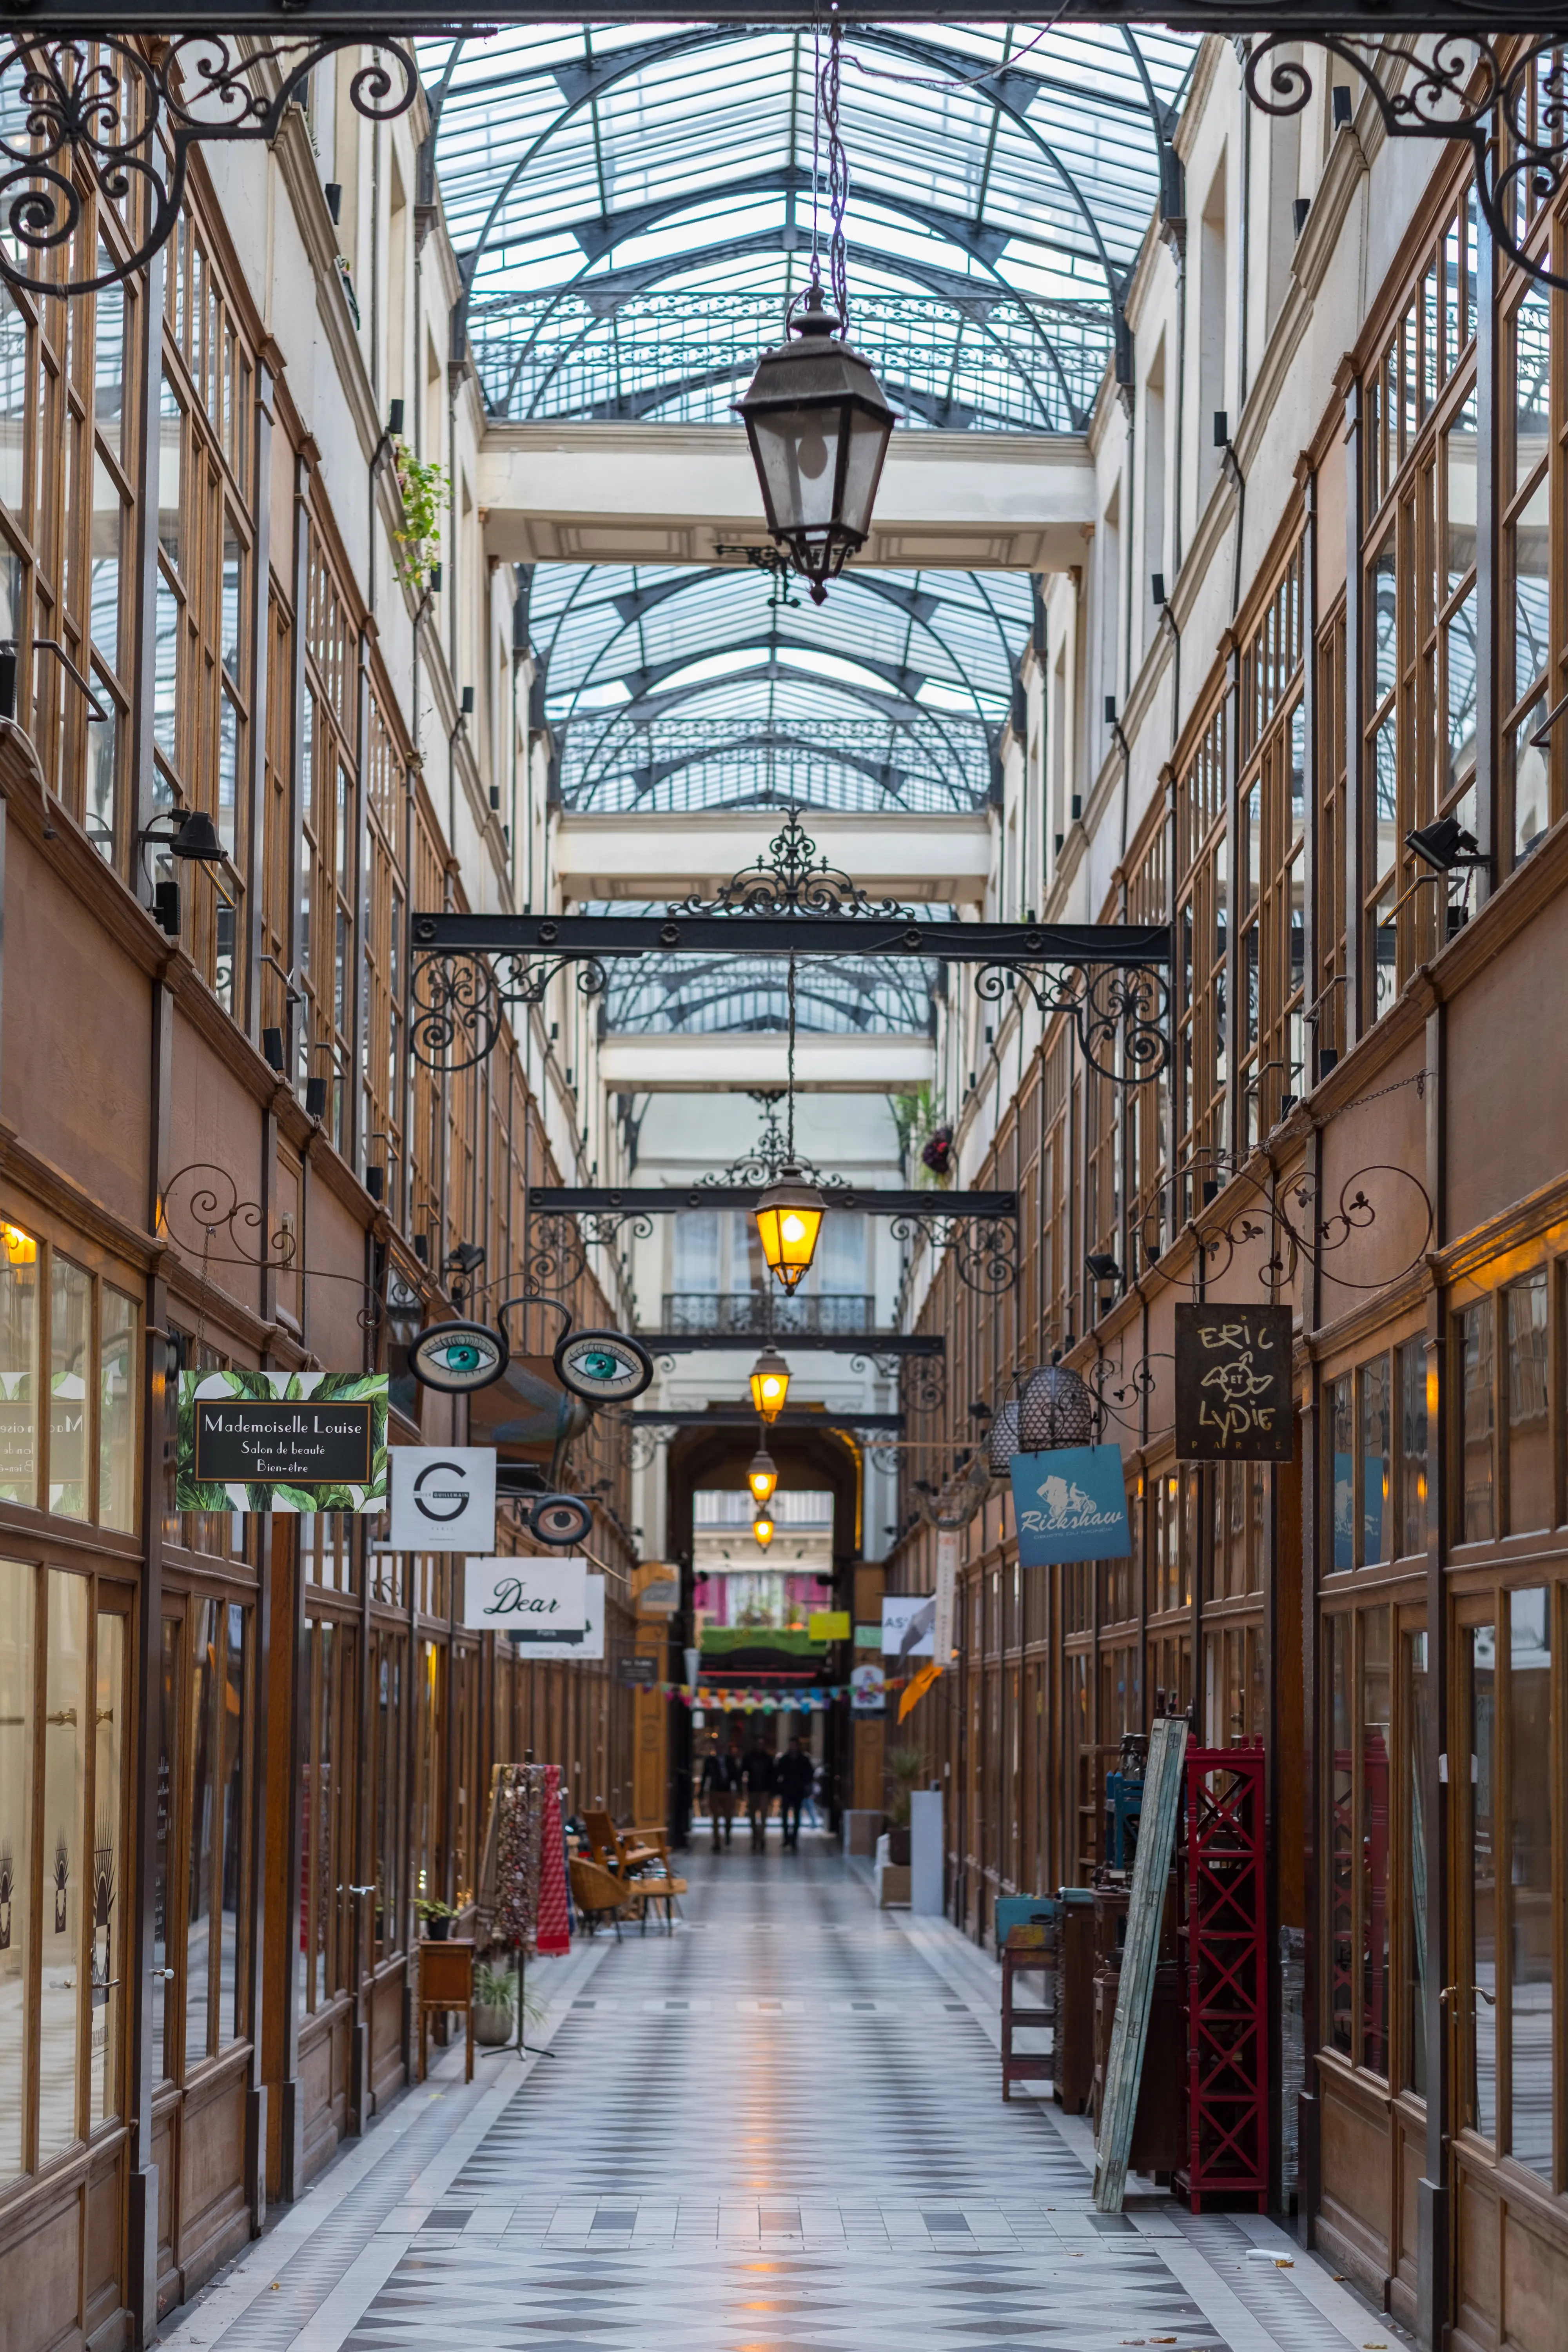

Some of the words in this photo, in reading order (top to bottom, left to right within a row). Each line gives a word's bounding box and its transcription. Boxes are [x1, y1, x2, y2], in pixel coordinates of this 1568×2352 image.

[1230, 1375, 1243, 1384] ET
[205, 1414, 308, 1433] Mademoiselle
[314, 1416, 361, 1433] Louise
[241, 1441, 272, 1454] Salon
[277, 1442, 287, 1454] de
[292, 1442, 325, 1454] beauté
[257, 1459, 308, 1472] Bien-être
[1021, 1506, 1124, 1532] Rickshaw
[483, 1578, 560, 1614] Dear
